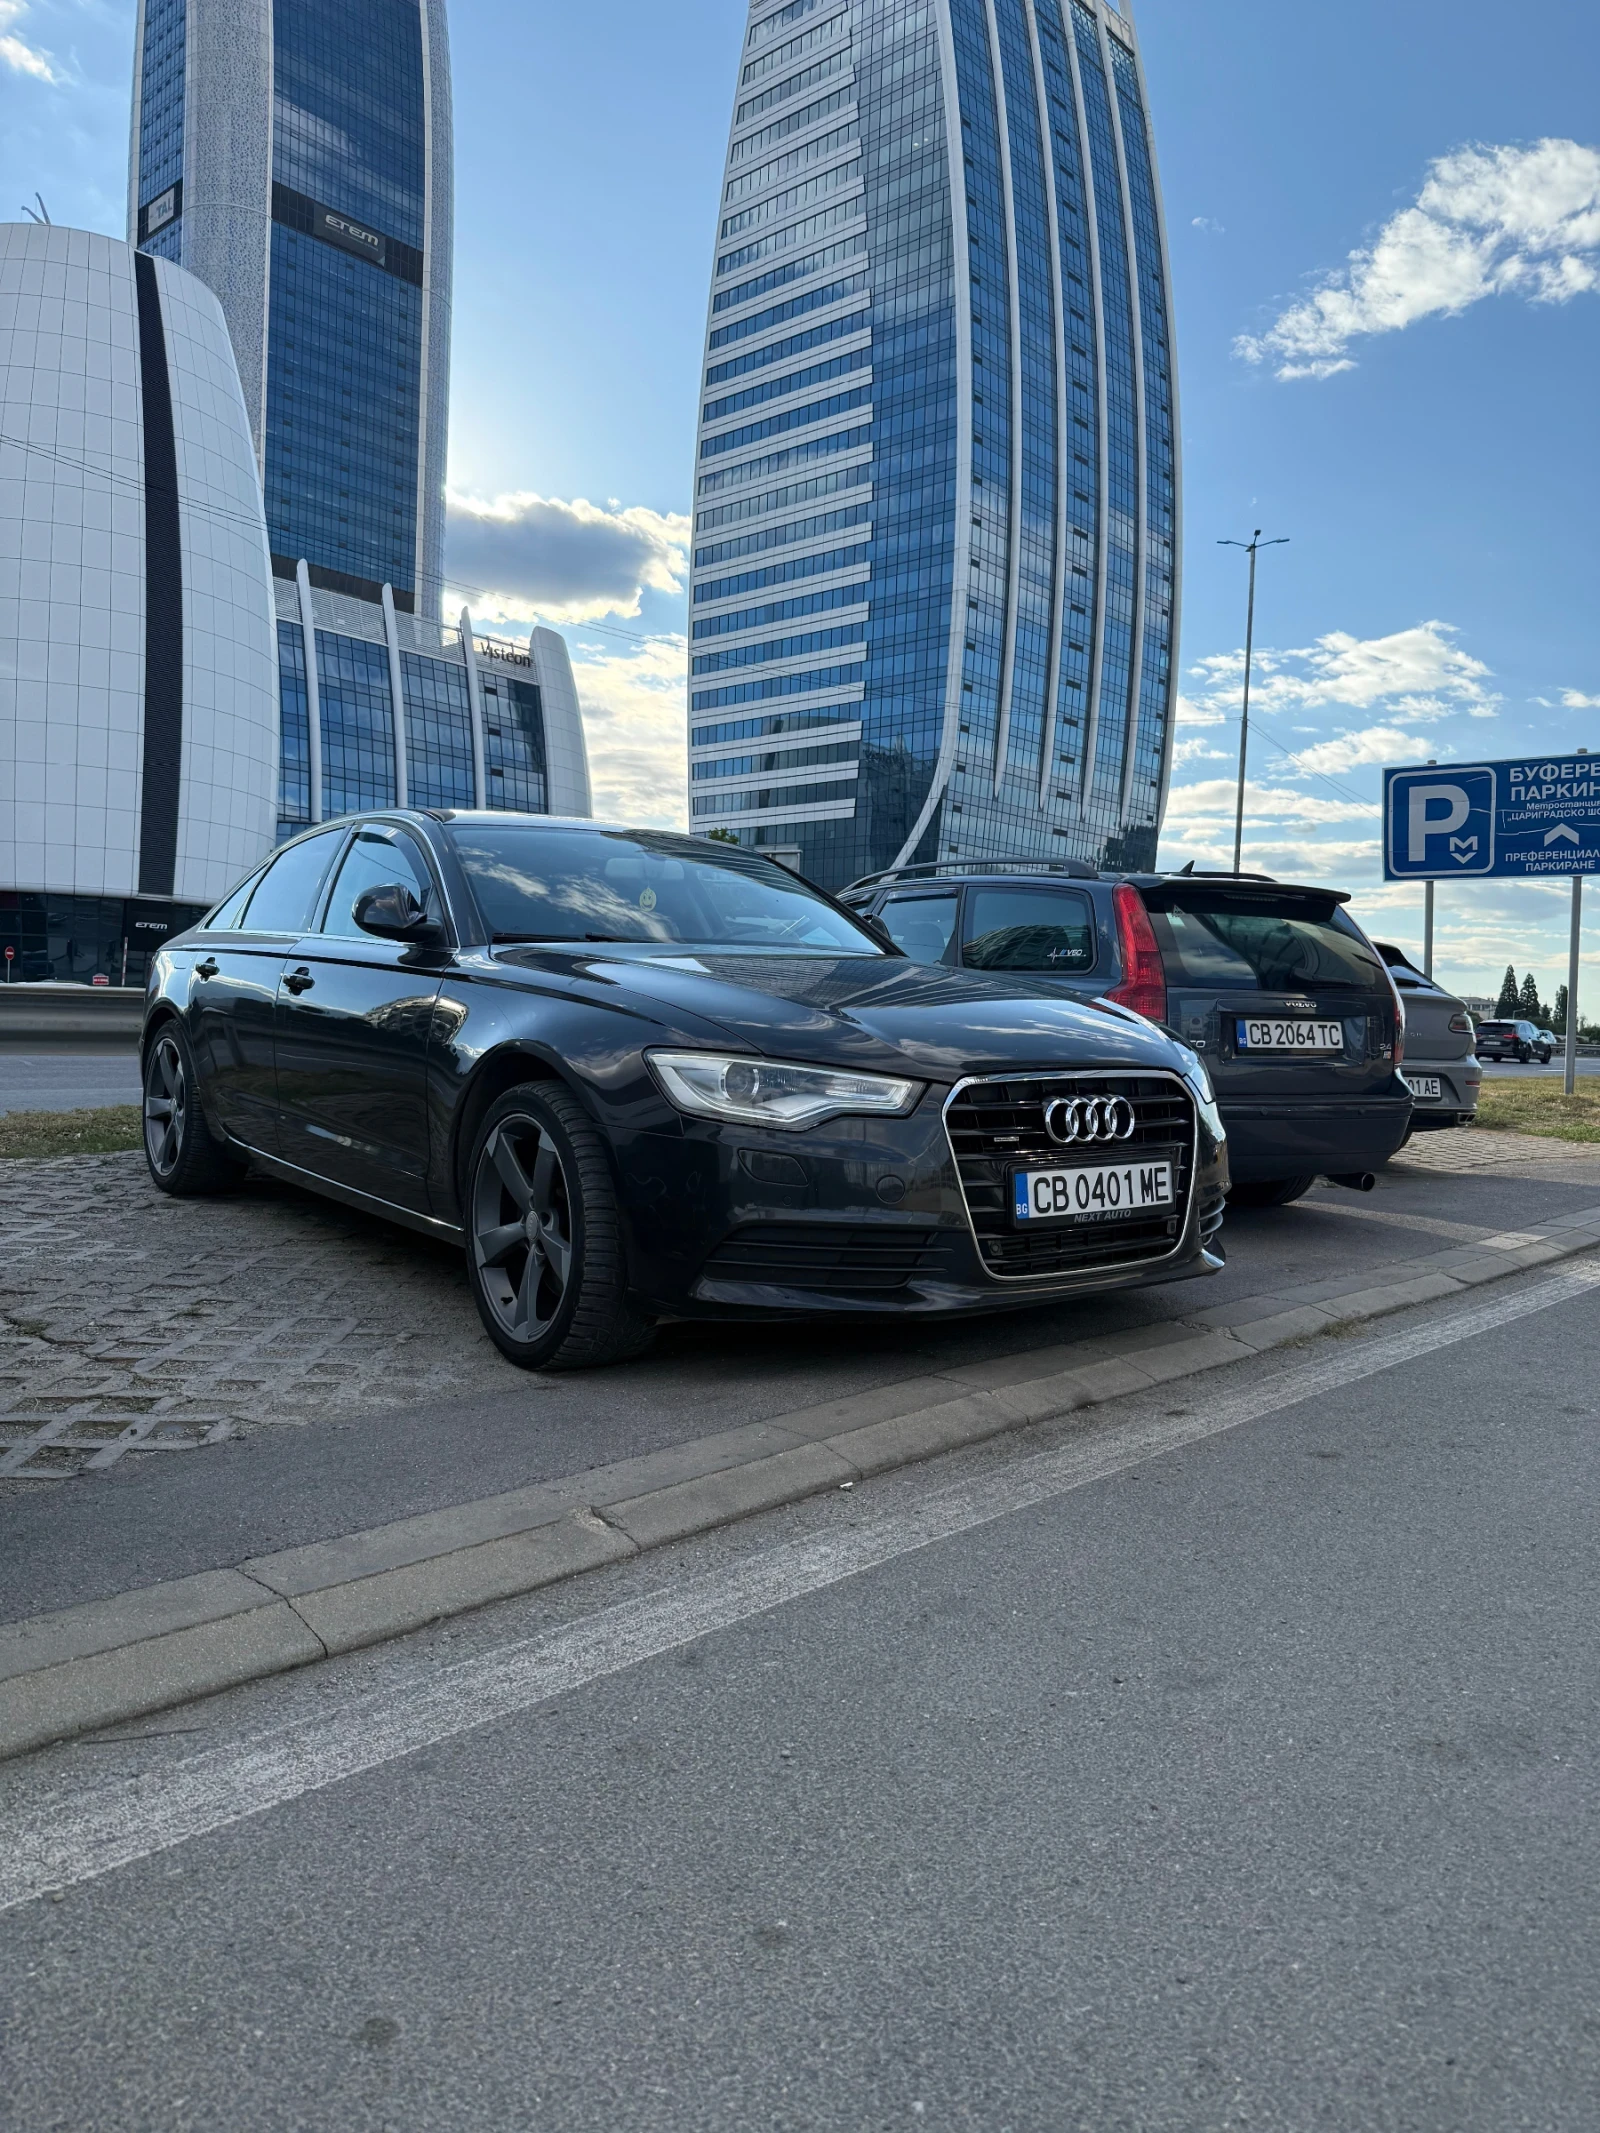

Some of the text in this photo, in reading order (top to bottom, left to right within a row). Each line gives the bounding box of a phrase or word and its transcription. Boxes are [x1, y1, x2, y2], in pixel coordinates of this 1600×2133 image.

[480, 641, 531, 668] Visteon
[1511, 782, 1600, 801] ПАРКИН
[1408, 784, 1470, 862] P
[1525, 860, 1596, 872] ПАРКИРАНЕ
[1285, 1000, 1317, 1009] VOLVO
[1249, 1023, 1340, 1046] CB 2064 TC
[1424, 1080, 1439, 1095] AE
[1033, 1166, 1169, 1214] CB 0401 ME
[1015, 1203, 1028, 1215] BG
[1073, 1209, 1131, 1223] NEXT AUTO
